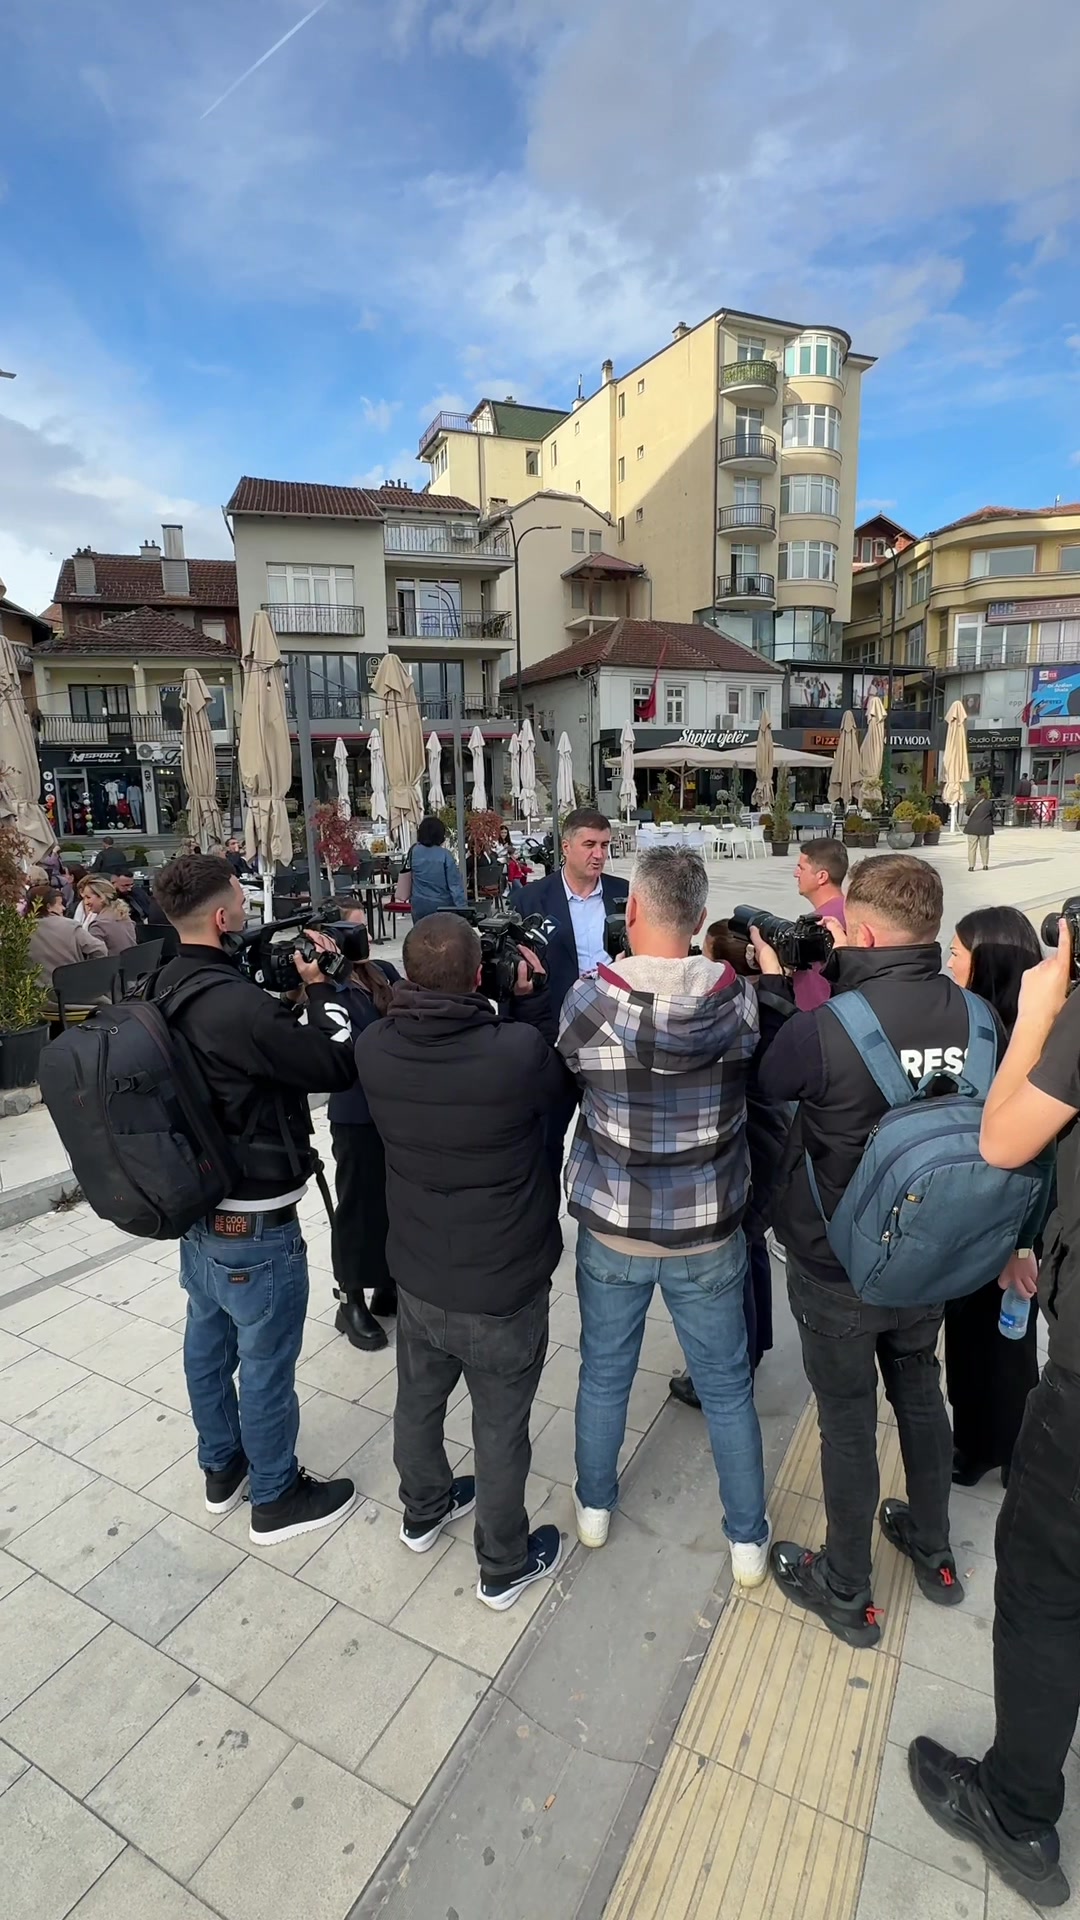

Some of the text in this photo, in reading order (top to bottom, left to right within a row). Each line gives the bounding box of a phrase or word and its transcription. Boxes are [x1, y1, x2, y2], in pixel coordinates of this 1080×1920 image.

[679, 728, 749, 748] Shpija vjetër
[884, 735, 931, 746] ITYMODA
[968, 736, 990, 744] Studio
[900, 1046, 968, 1078] RES
[215, 1215, 247, 1224] BE COOL
[215, 1223, 247, 1232] BE NICE
